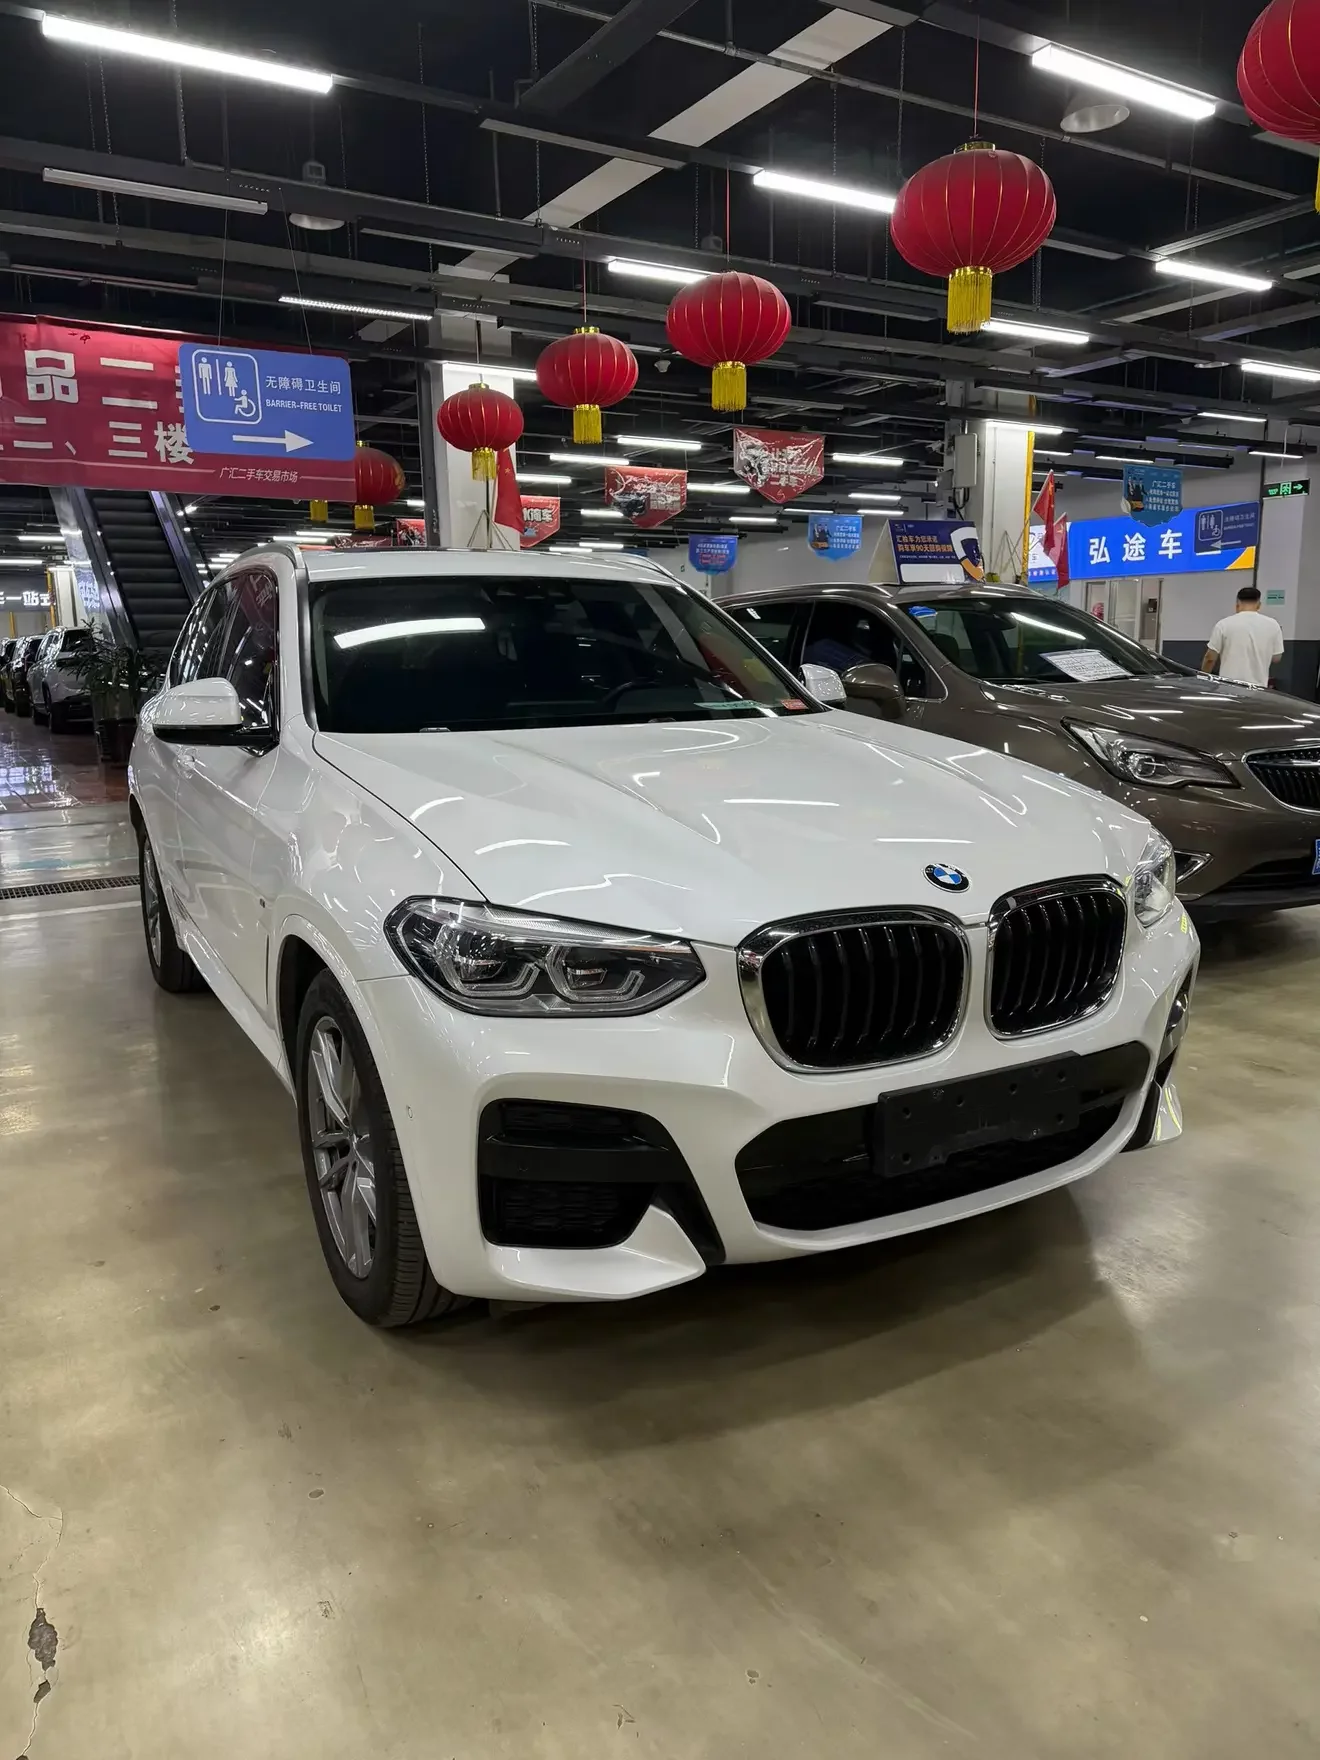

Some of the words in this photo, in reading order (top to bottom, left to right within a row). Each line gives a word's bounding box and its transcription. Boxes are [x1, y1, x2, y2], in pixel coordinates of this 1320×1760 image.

[0, 349, 185, 413] 品二
[265, 375, 342, 396] 无障碍卫生间
[265, 399, 317, 411] BARRIER-FREE
[318, 403, 343, 413] TOILET
[0, 416, 195, 465] 二、三楼
[219, 466, 299, 484] 广汇二手车交易市场
[1089, 529, 1222, 565] 弘途车
